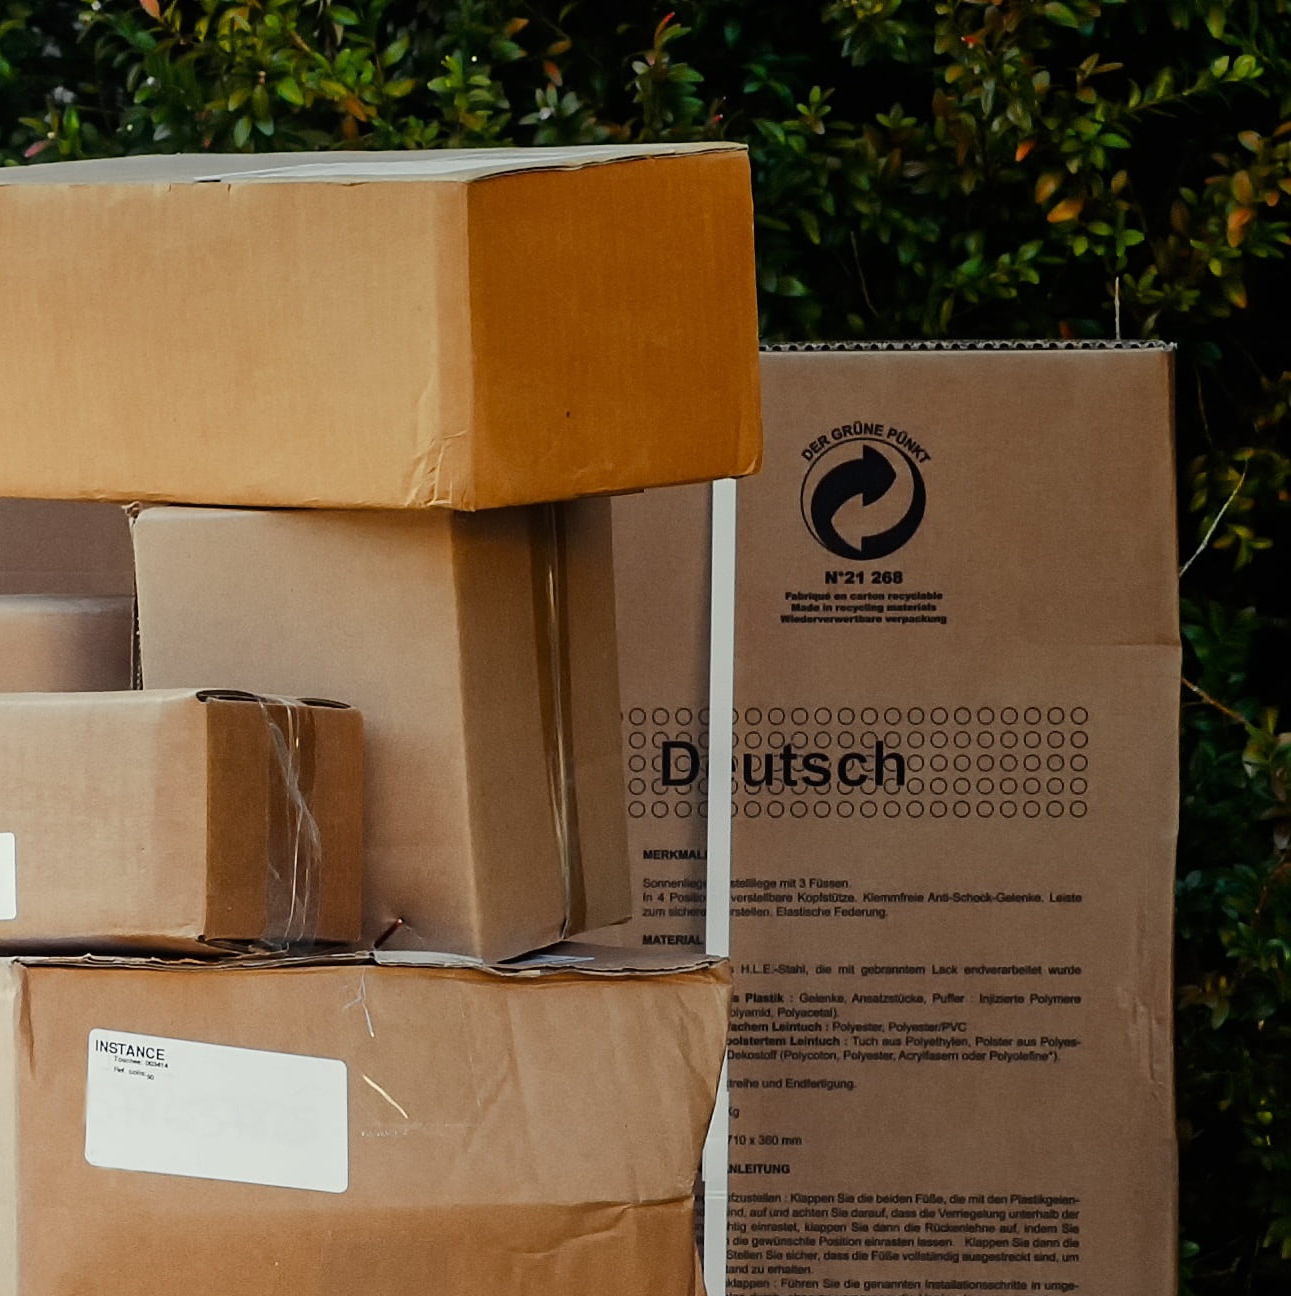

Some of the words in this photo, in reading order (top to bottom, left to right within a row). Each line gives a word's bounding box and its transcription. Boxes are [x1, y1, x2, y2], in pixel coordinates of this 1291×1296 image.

[801, 435, 830, 462] DER
[831, 421, 885, 441] GRÜNE
[871, 570, 903, 584] 268
[785, 591, 831, 602] Fabriqué
[834, 593, 847, 601] en
[850, 592, 884, 601] carton
[888, 591, 943, 602] recyclable
[791, 603, 820, 612] Made
[823, 603, 833, 612] in
[836, 603, 884, 614] recycling
[887, 603, 937, 612] materials
[886, 615, 947, 625] verpackung
[661, 740, 906, 787] Dutsch
[95, 1039, 166, 1061] INSTANCE
